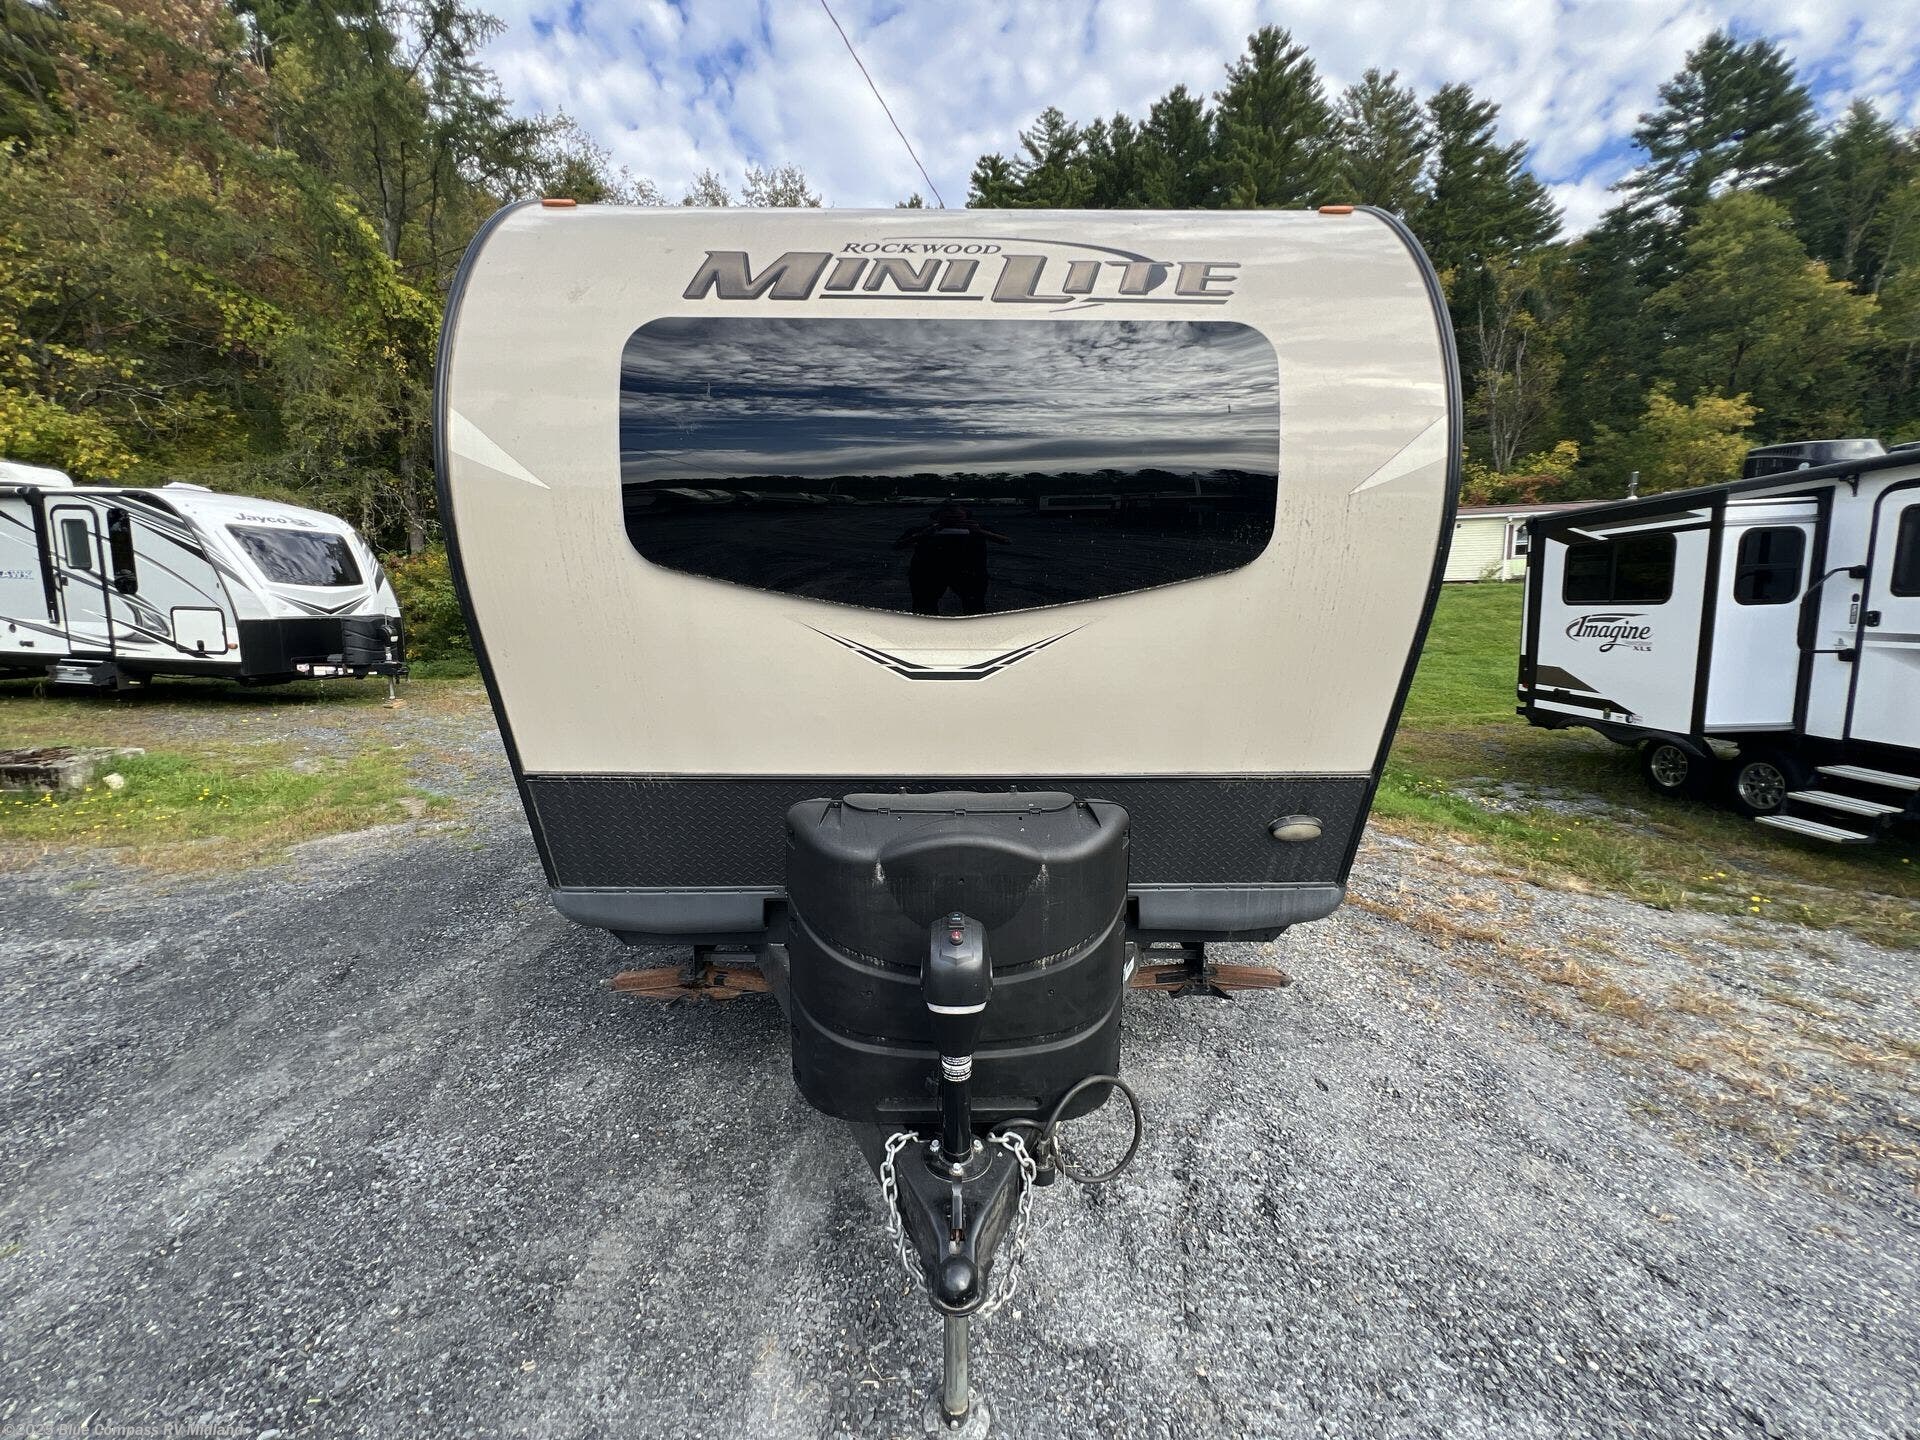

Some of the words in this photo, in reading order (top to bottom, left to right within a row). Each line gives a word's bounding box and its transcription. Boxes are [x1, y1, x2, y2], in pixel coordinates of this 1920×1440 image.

[842, 242, 1002, 255] ROCKWOOD
[235, 512, 287, 523] Jayco
[1570, 614, 1655, 652] Imagine
